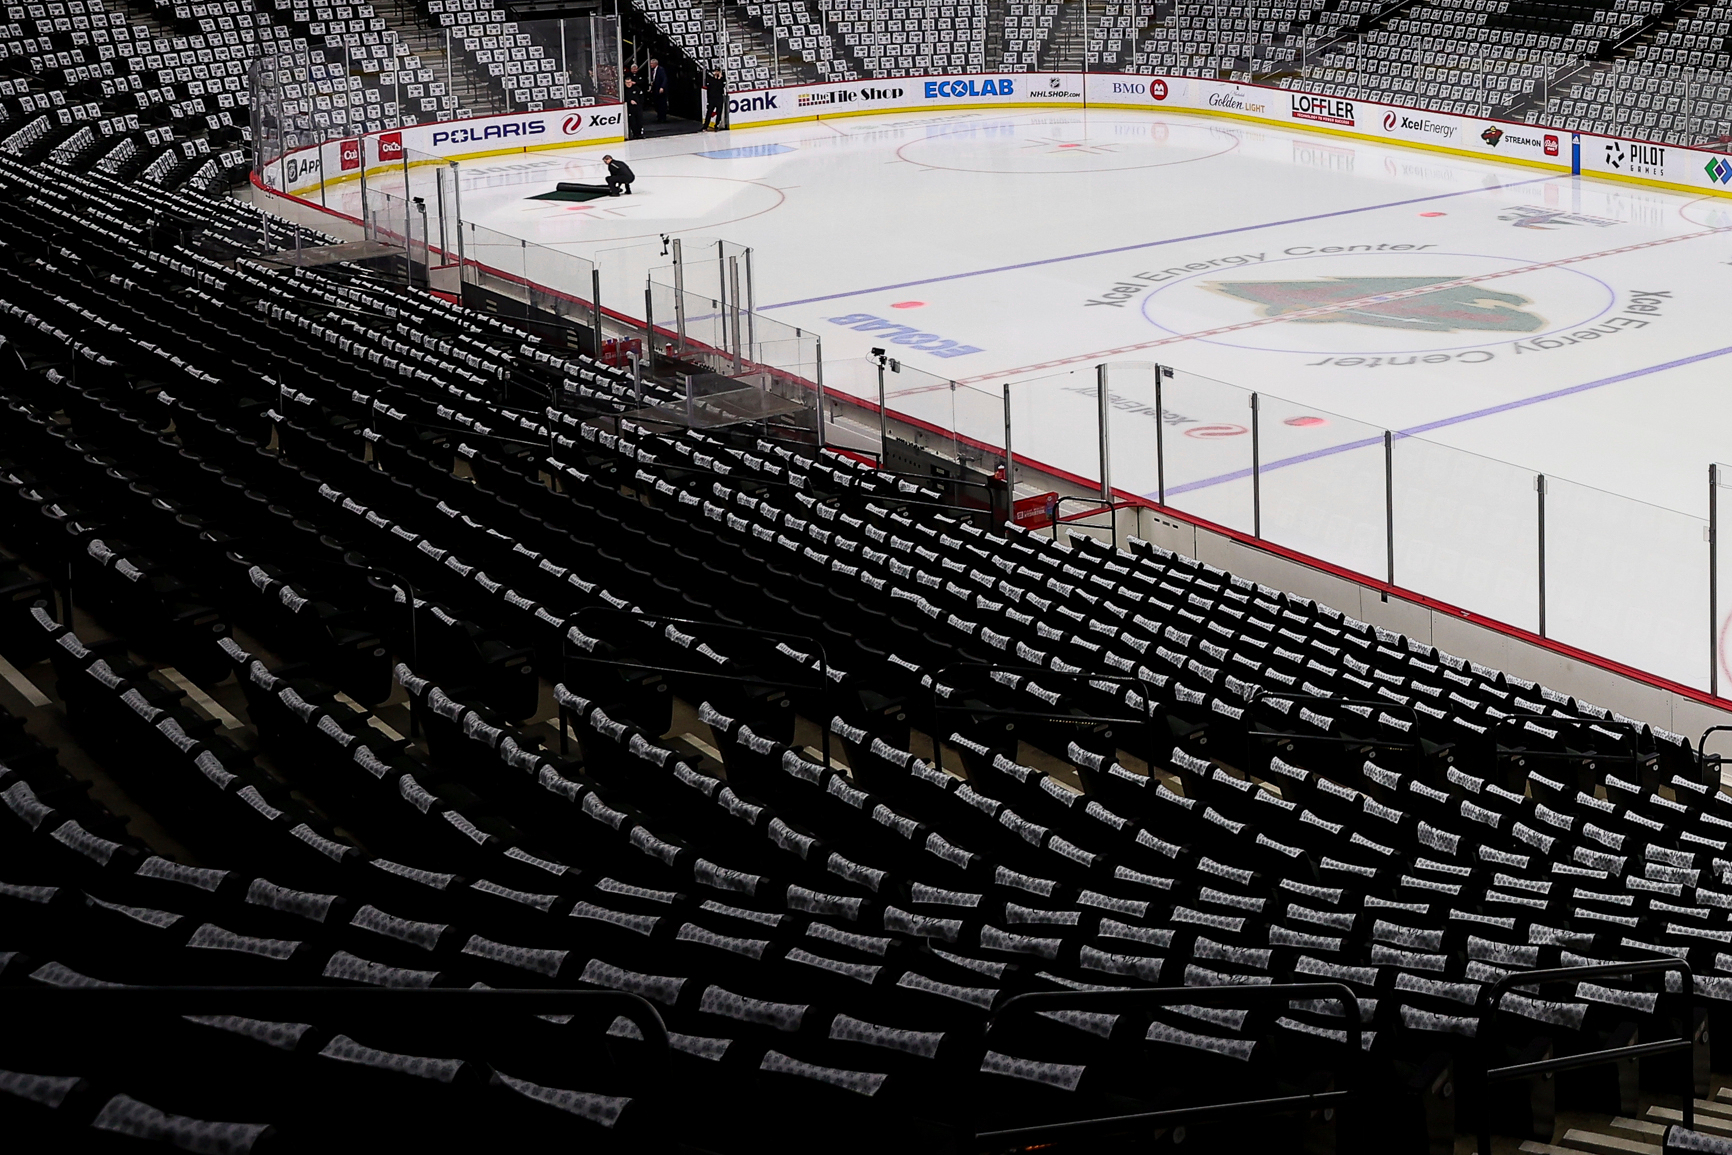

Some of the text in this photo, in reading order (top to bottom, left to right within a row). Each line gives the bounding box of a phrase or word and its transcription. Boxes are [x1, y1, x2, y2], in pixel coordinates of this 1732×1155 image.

[810, 86, 904, 106] The Tile Shop
[924, 78, 1014, 99] ECOLAB
[1030, 89, 1081, 98] NHLSHOP.COM
[1112, 82, 1146, 95] BMO
[728, 91, 778, 114] bank
[1209, 93, 1244, 110] Golden
[1245, 103, 1266, 114] LIGHT
[1291, 94, 1355, 120] LOFFLER
[589, 112, 622, 127] Xcel
[1400, 116, 1456, 139] Xcel Energy
[433, 119, 547, 146] POLARIS
[1504, 133, 1542, 147] STREAM ON
[1630, 143, 1666, 169] PILOT
[1630, 165, 1665, 177] GAMES
[1084, 243, 1438, 310] Xcel Energy Center
[824, 312, 986, 359] ECOLAB
[1304, 288, 1673, 370] Xcel Energy Center
[1063, 386, 1198, 428] Xcel Energy
